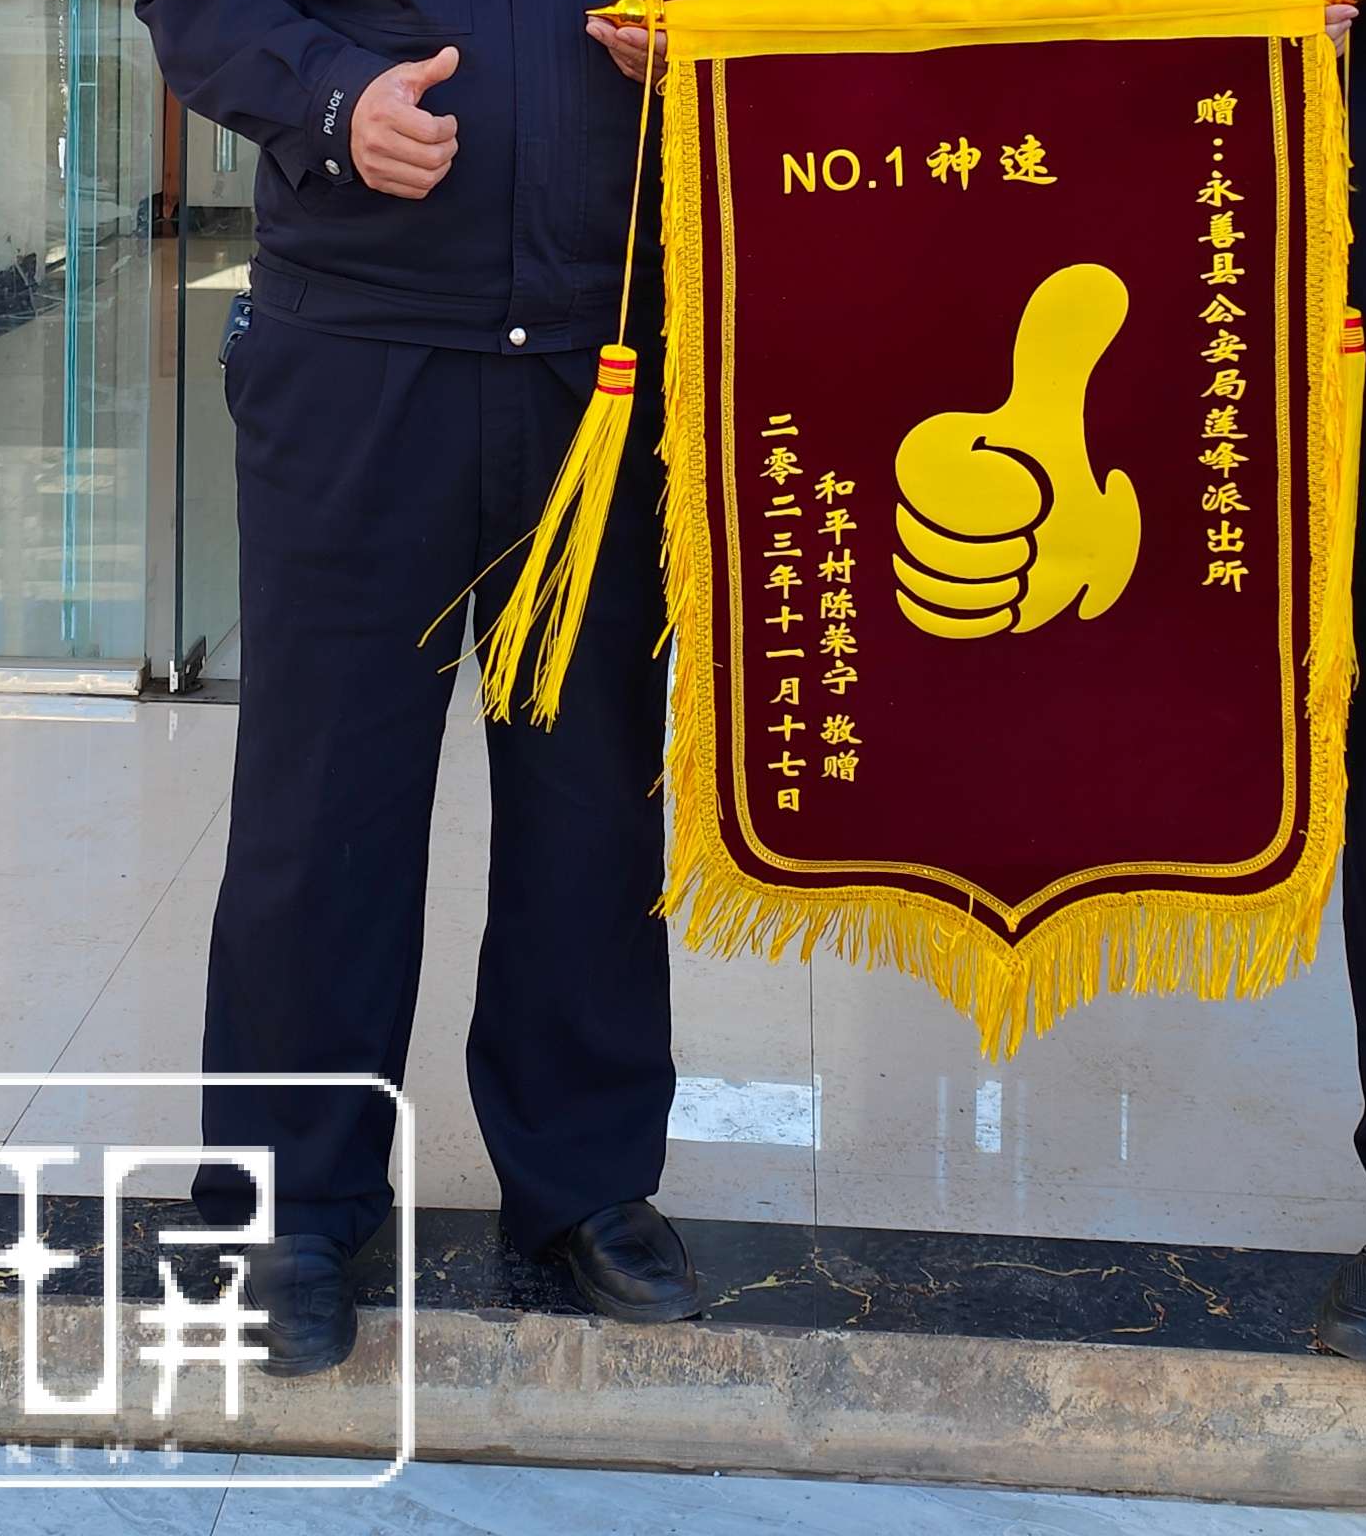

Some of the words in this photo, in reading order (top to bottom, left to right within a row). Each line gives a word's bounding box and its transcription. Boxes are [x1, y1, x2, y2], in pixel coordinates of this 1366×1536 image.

[323, 89, 345, 135] POLICE
[782, 146, 903, 195] NO.1
[926, 134, 1059, 191] 神速
[759, 413, 807, 813] 二零二三年十一月十七日
[820, 714, 862, 782] 敬赠
